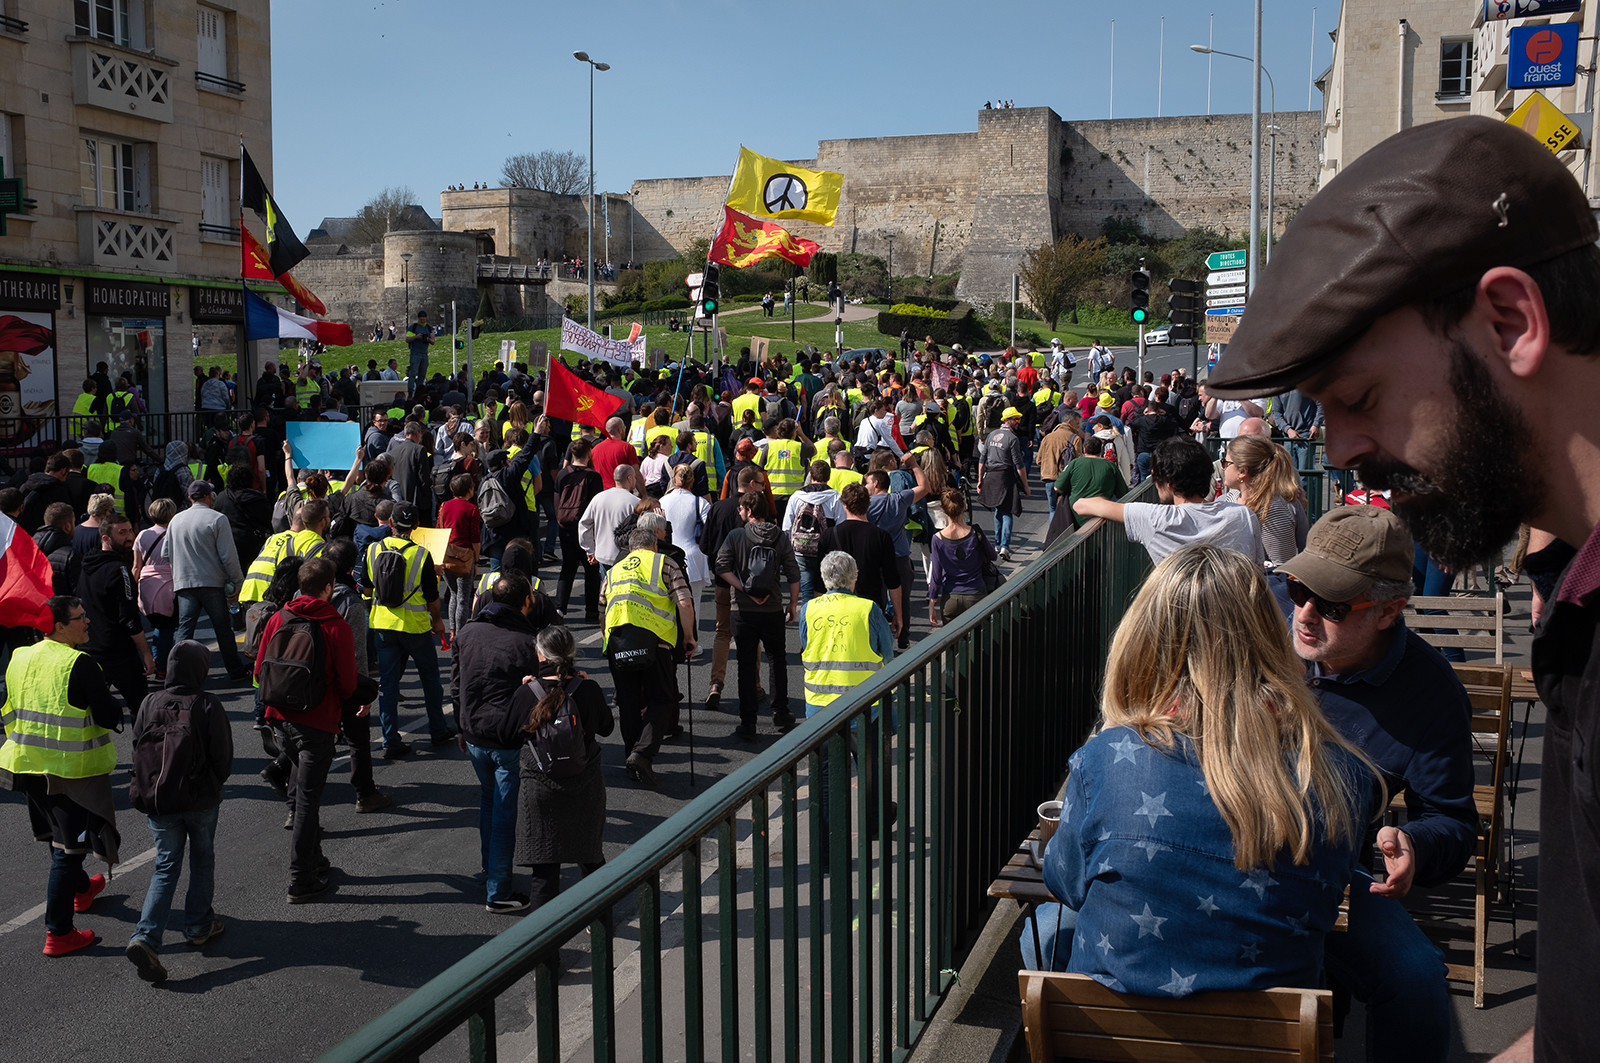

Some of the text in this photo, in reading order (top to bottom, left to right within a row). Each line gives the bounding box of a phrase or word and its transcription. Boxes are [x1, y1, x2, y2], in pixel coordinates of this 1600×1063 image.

[1524, 71, 1562, 83] france
[1528, 62, 1562, 74] ouest
[1543, 124, 1572, 152] SSE
[1220, 259, 1245, 267] DIRECTIONS
[0, 280, 58, 301] THERAPIE
[93, 287, 168, 308] HOMEOPATHIE
[199, 288, 243, 306] PHARMA
